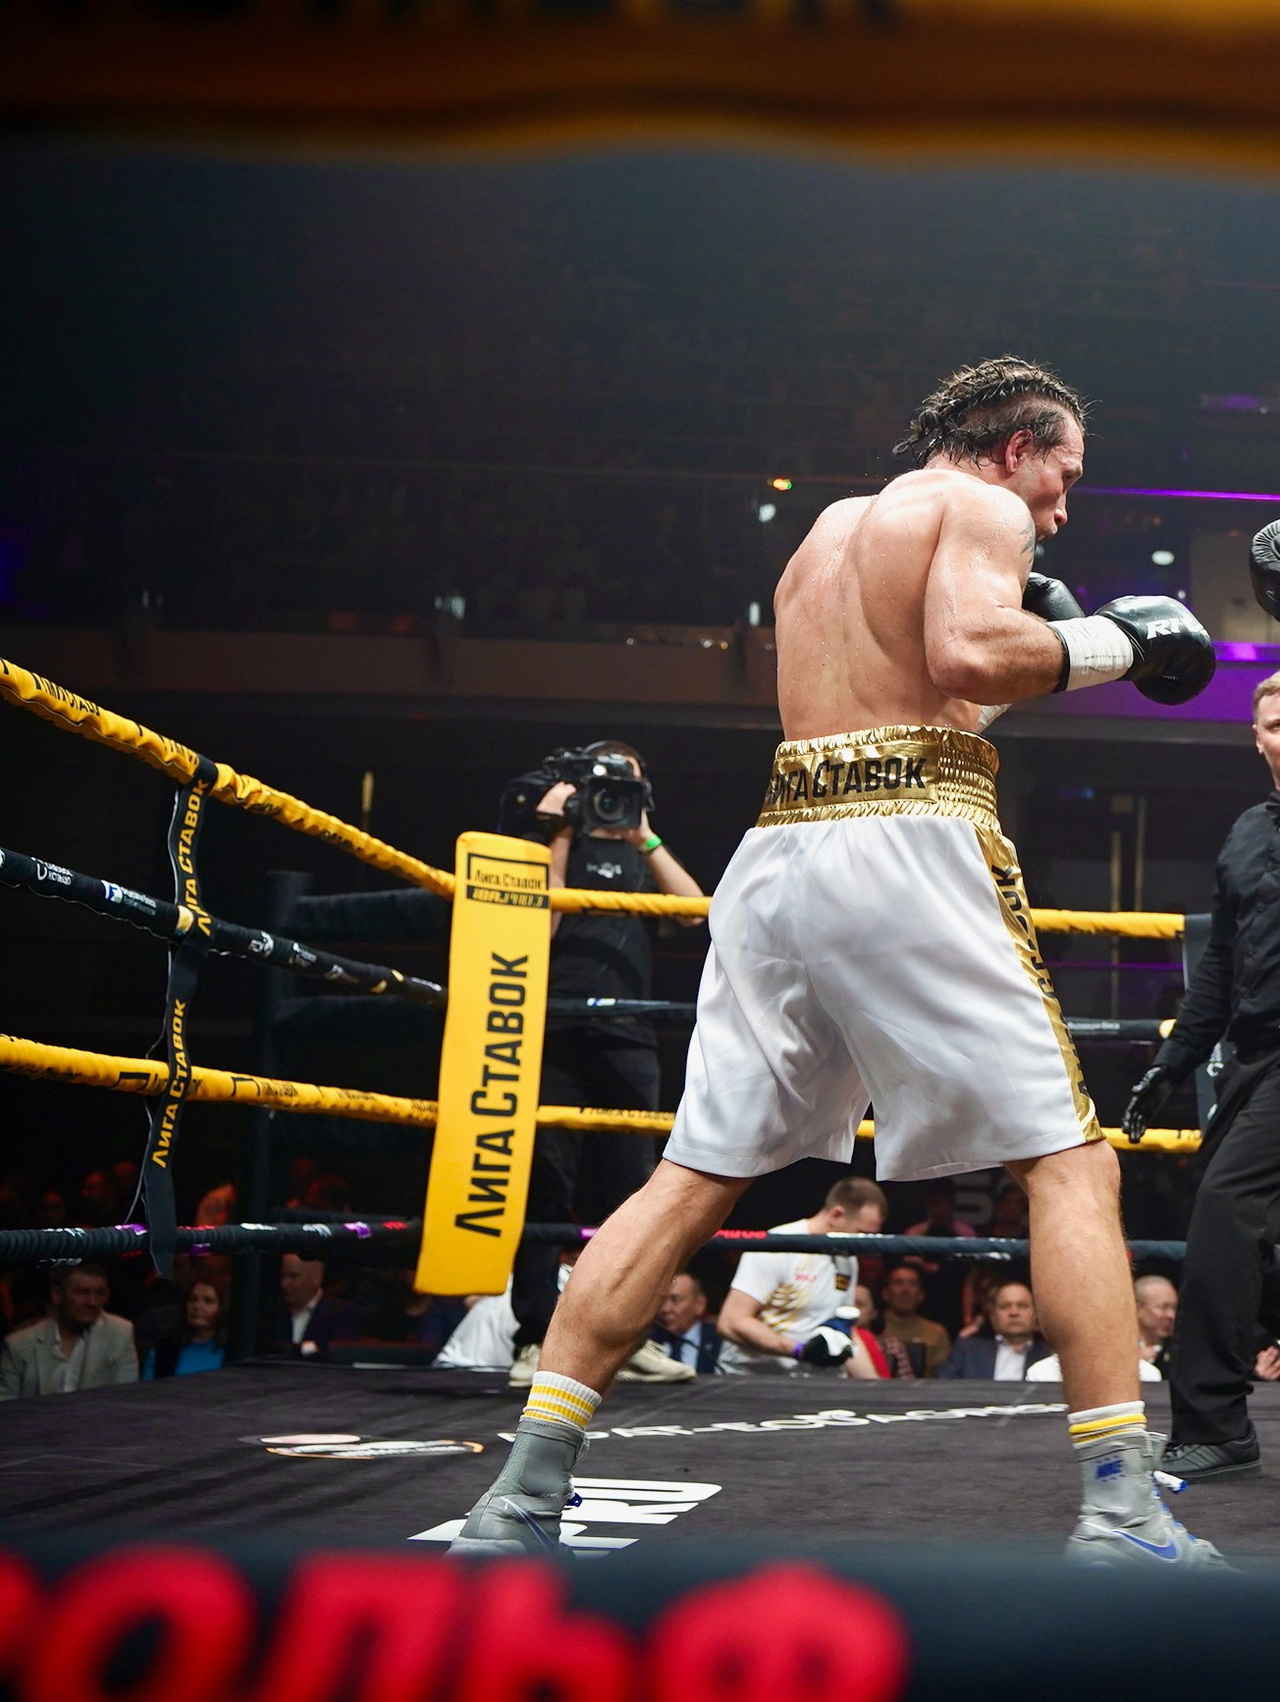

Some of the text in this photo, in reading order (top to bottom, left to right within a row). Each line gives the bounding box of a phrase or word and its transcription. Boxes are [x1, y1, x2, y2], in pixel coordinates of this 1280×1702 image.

[813, 757, 927, 798] СТАВОК
[151, 998, 187, 1169] ЛИГА СТАВОК
[470, 952, 529, 1118] СТАВОК
[454, 1129, 515, 1238] ЛИГА
